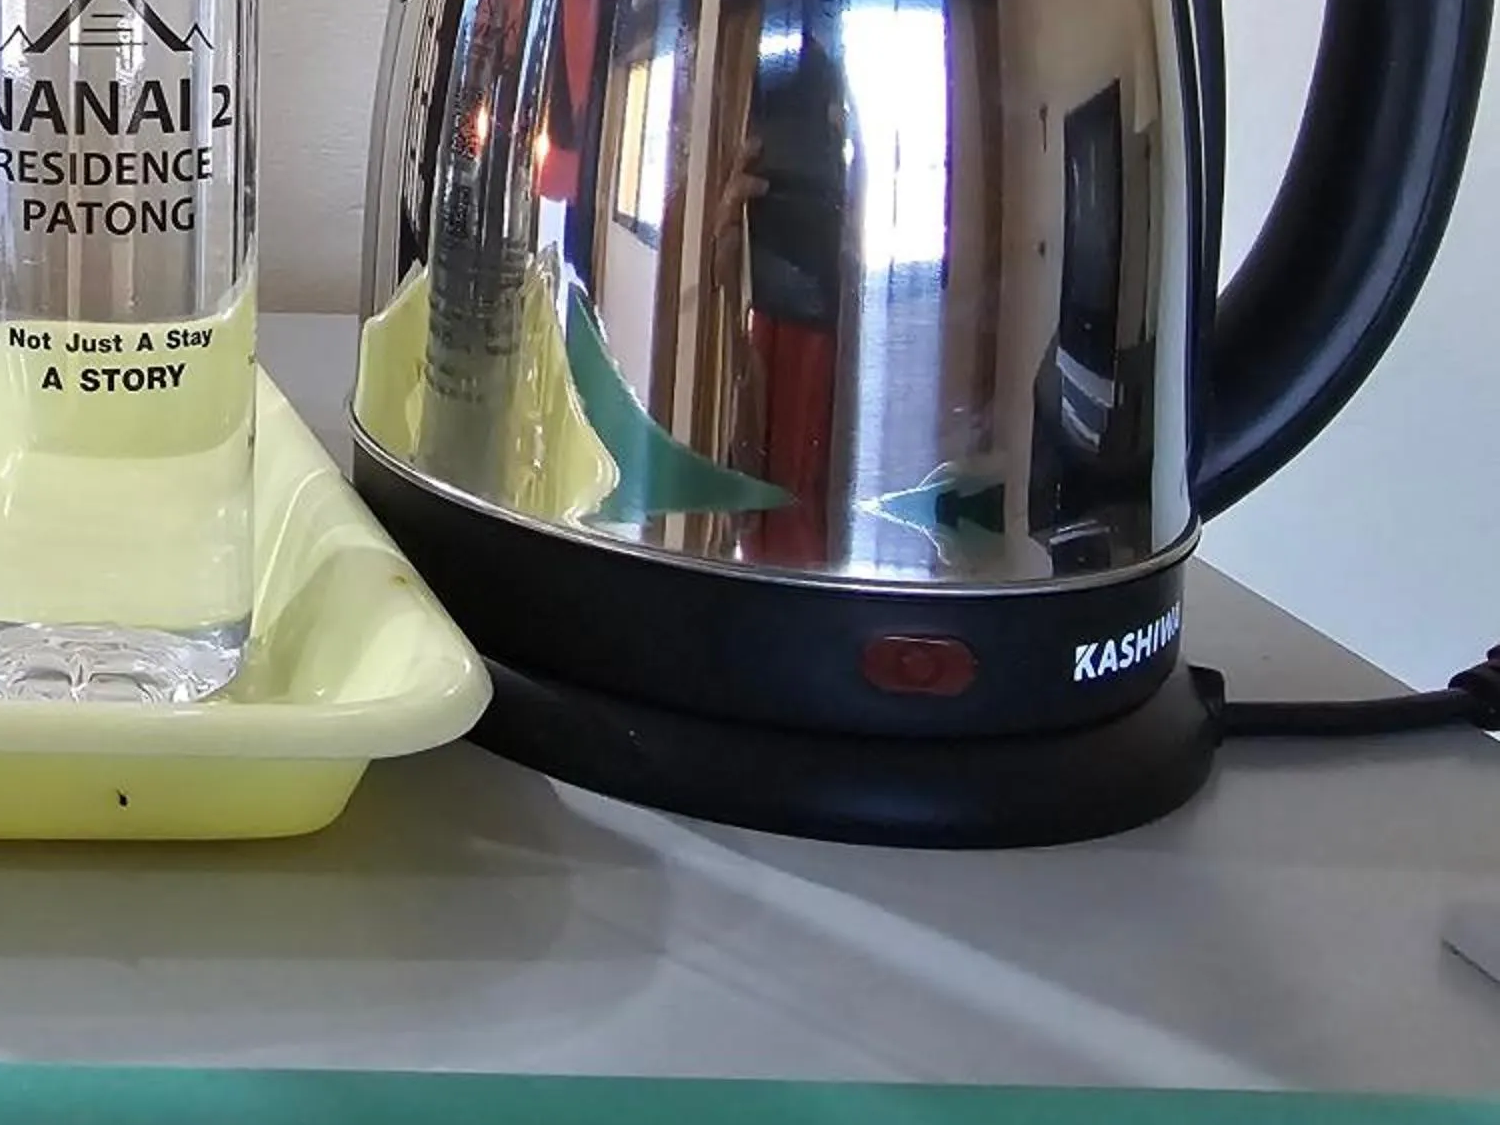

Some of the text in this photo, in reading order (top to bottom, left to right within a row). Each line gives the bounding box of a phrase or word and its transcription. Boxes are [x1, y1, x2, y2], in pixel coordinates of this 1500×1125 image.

[211, 85, 232, 127] 2
[23, 197, 195, 235] PATONG
[9, 326, 213, 353] Not Just A Stay
[42, 363, 185, 391] A STORY
